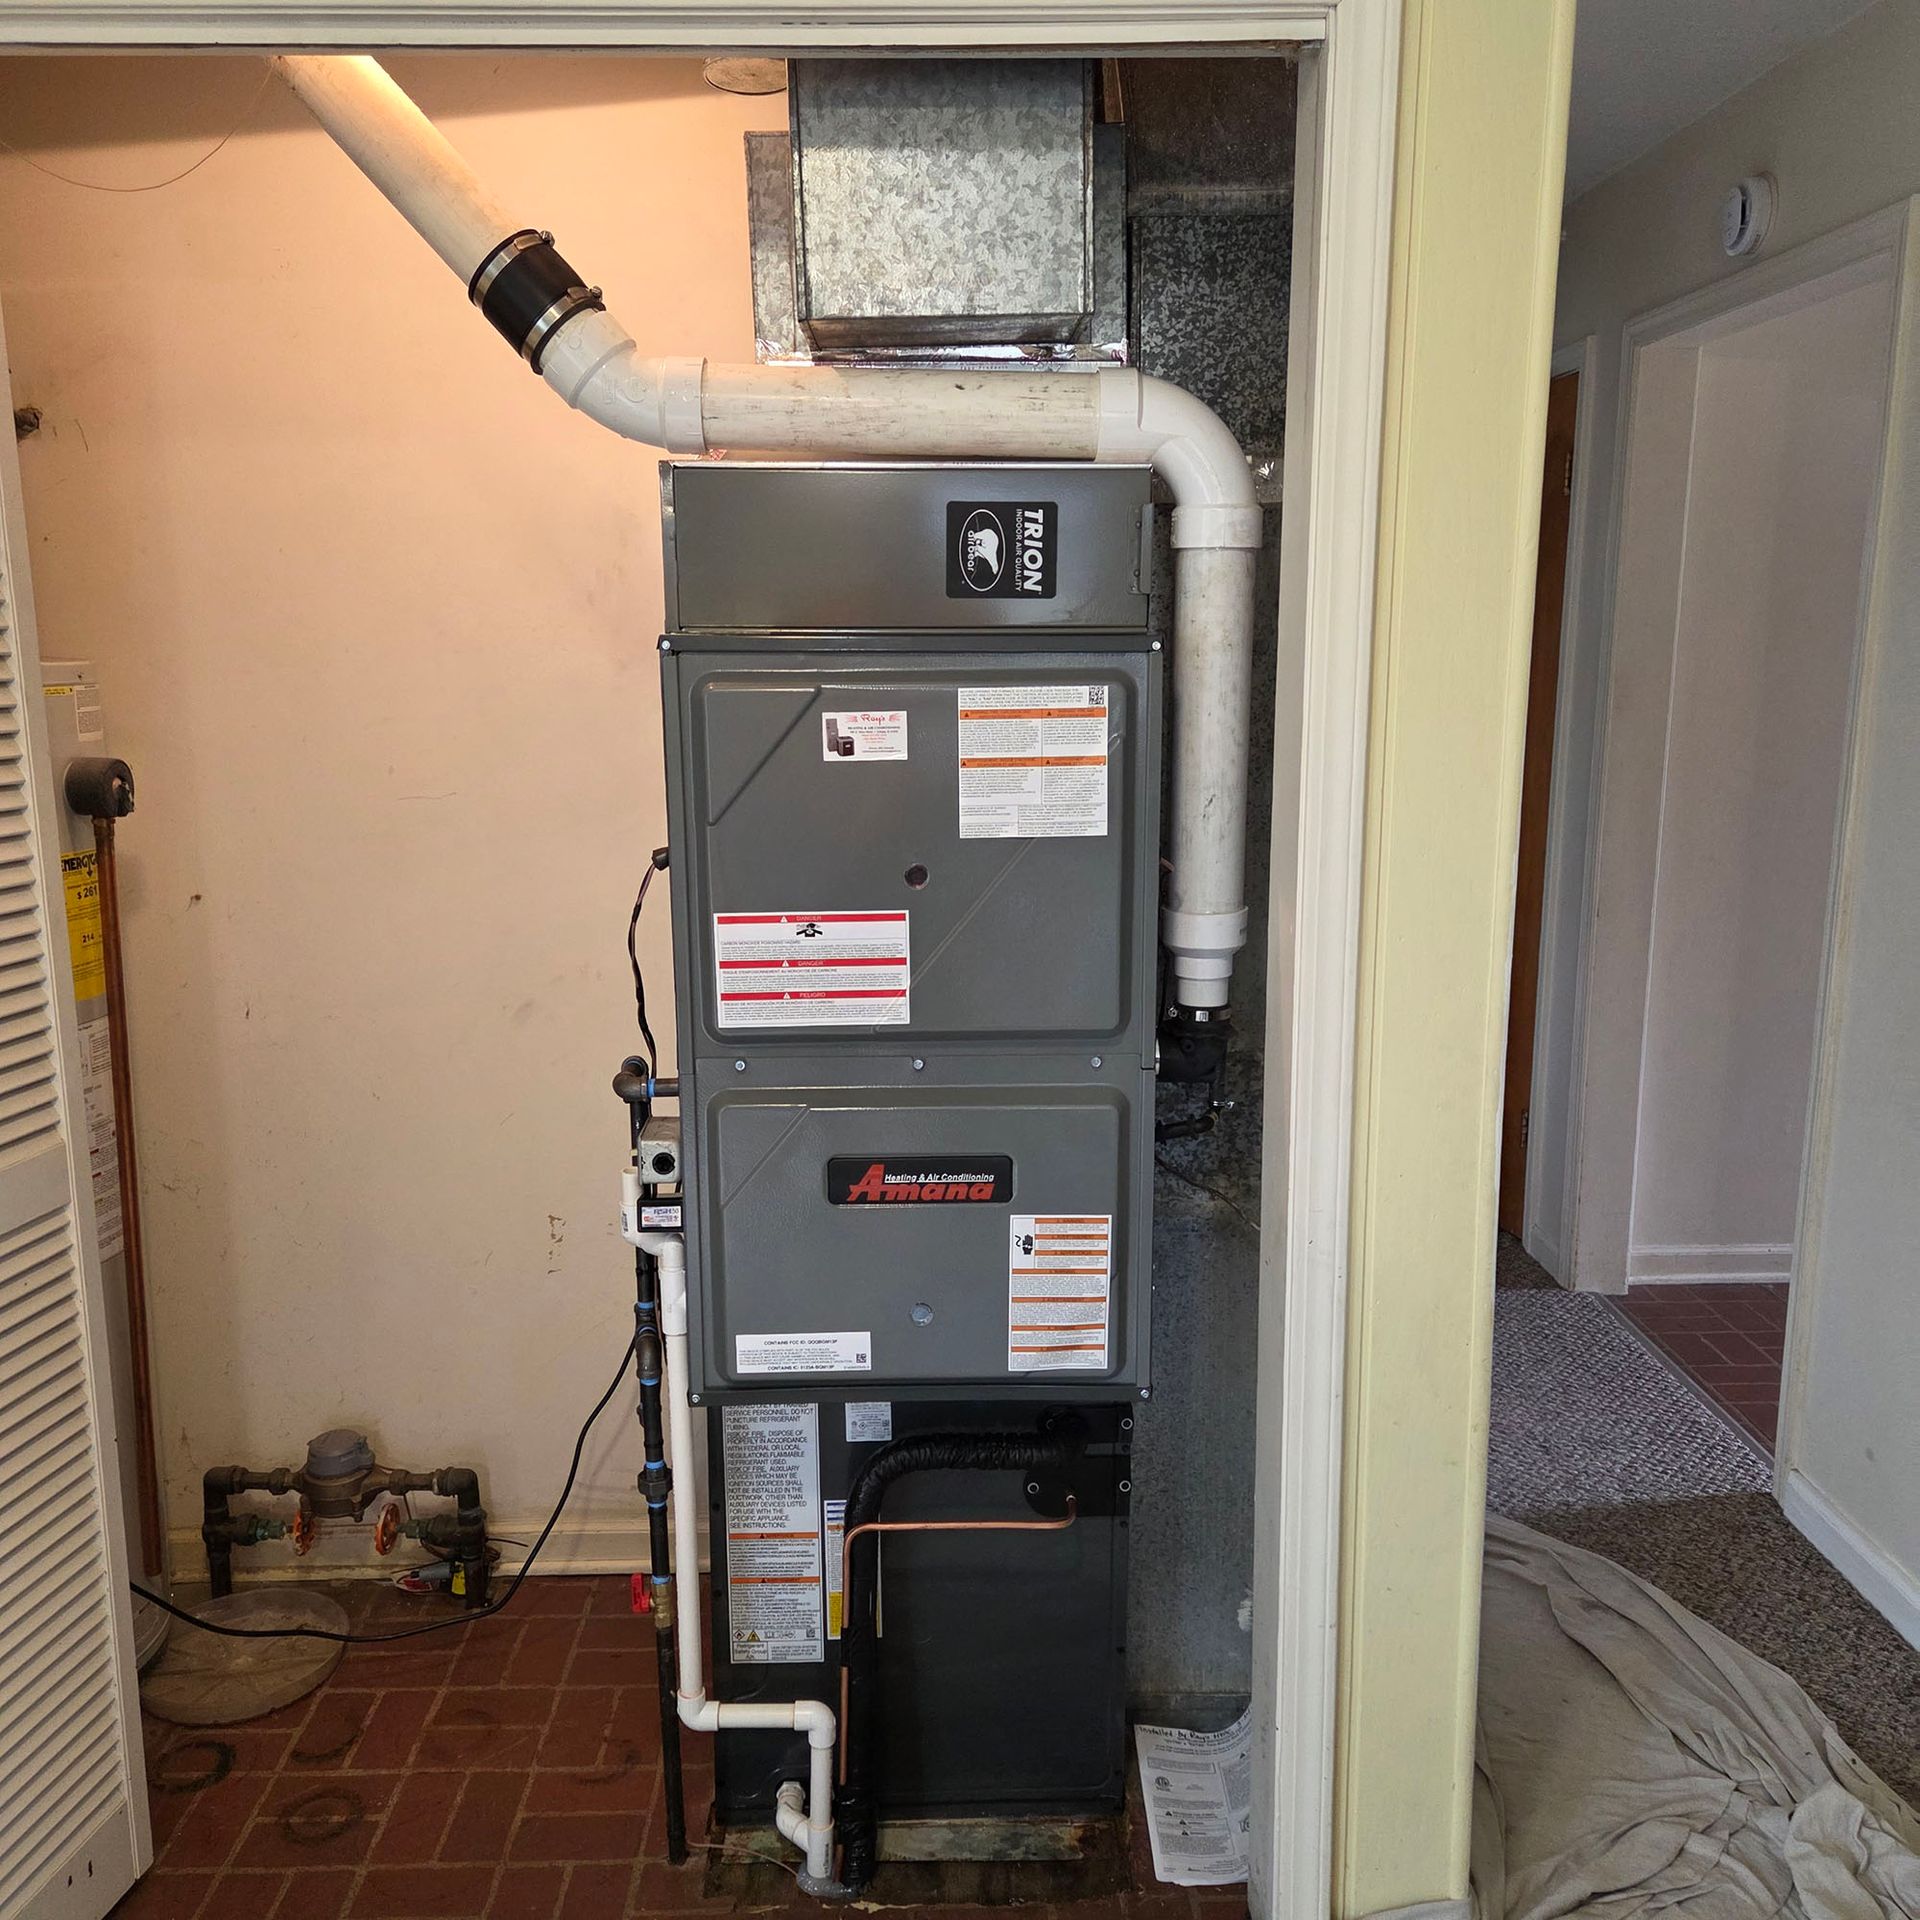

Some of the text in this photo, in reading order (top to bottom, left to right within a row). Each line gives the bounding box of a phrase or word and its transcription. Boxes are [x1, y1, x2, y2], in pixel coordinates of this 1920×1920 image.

[1023, 509, 1043, 592] TRION
[847, 1164, 995, 1201] Amana
[884, 1174, 917, 1183] Heating
[927, 1173, 939, 1181] Air
[941, 1173, 994, 1182] Conditioning
